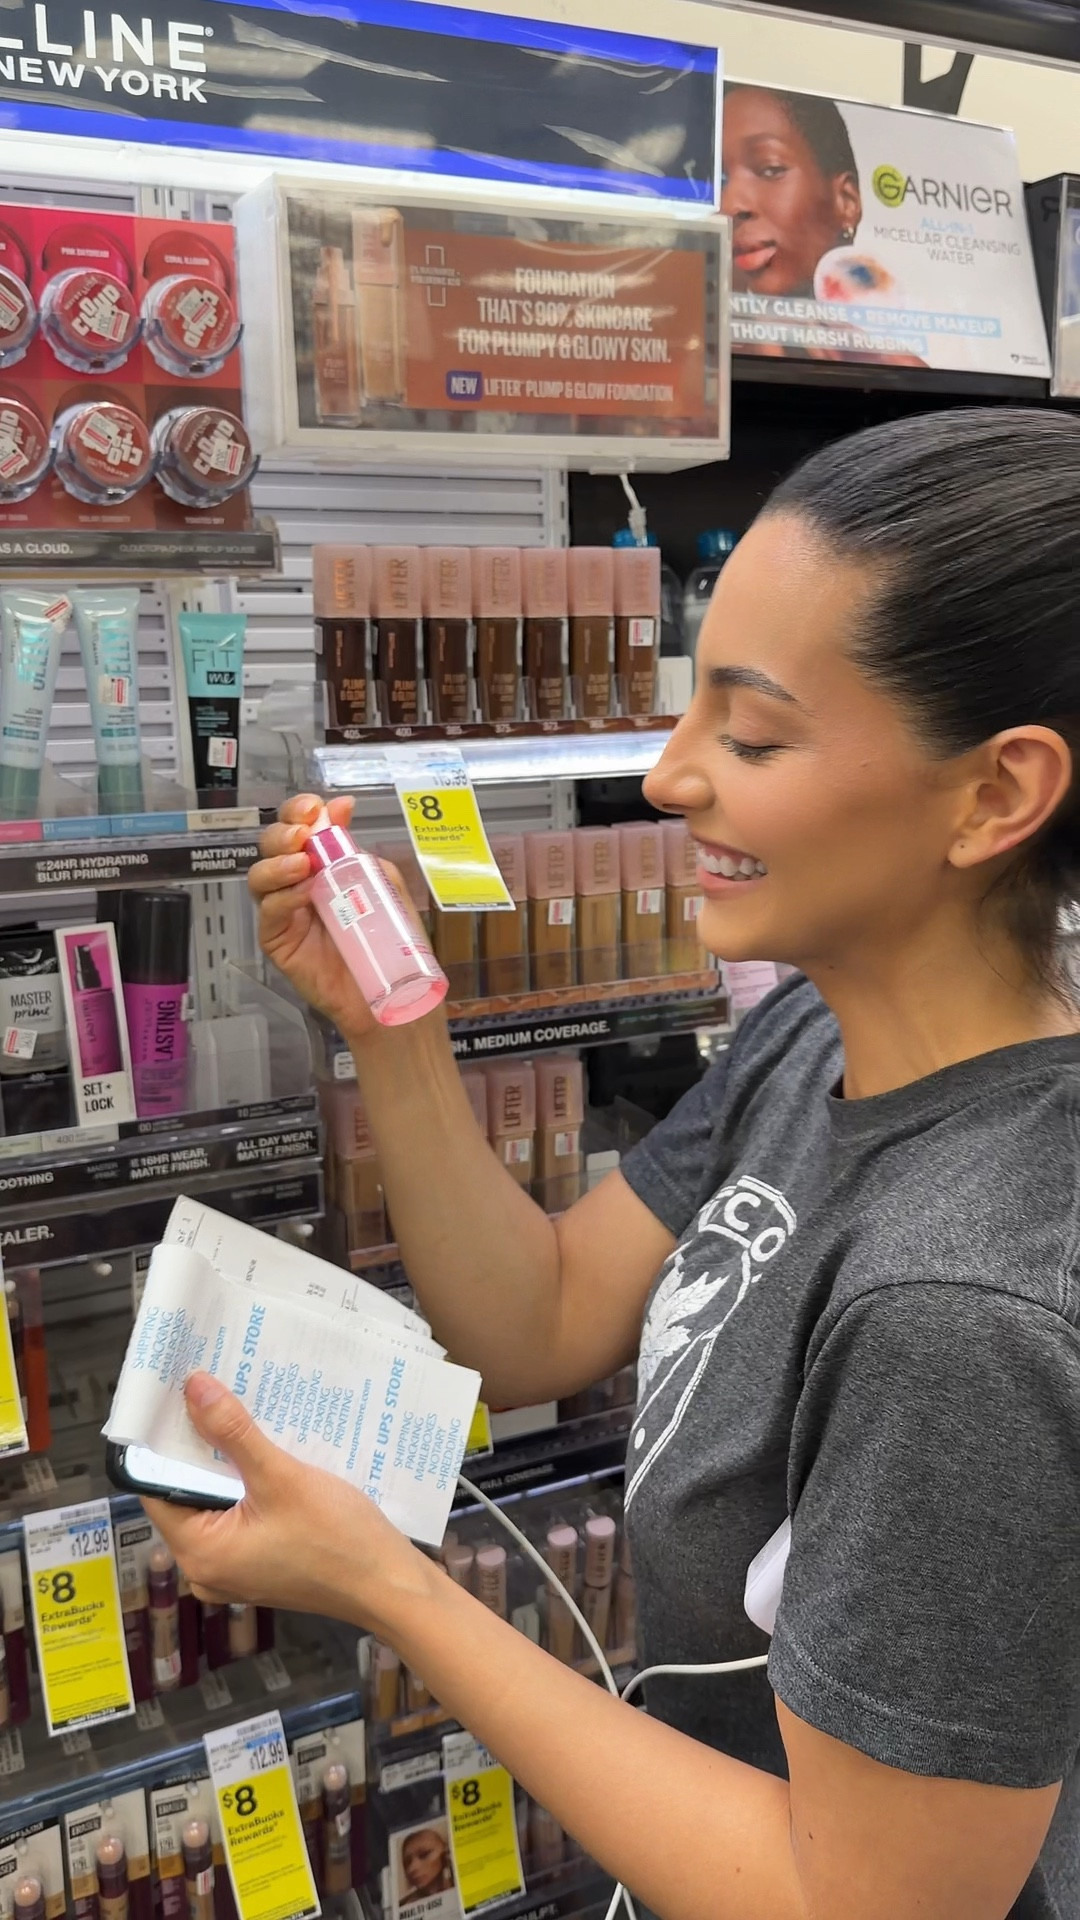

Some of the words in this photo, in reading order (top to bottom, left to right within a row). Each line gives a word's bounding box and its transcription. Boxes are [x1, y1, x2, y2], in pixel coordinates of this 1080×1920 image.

[94, 65, 208, 104] YORK
[873, 225, 942, 247] MICELLAR
[945, 234, 1021, 256] CLEANSING
[927, 249, 974, 265] WATER
[515, 268, 615, 298] FOUNDATION
[477, 297, 533, 326] THAT'S
[574, 303, 653, 331] SKINCARE
[773, 300, 848, 321] CLEANSE
[866, 311, 931, 330] REMOVE
[935, 317, 998, 336] MAKEUP
[457, 327, 493, 355] FOR
[493, 331, 559, 358] PLUMPY
[573, 335, 629, 361] GLOWY
[631, 338, 672, 363] SKIN.
[794, 328, 850, 348] HARSH
[853, 336, 923, 354] RUBBING
[450, 377, 478, 395] NEW
[525, 380, 564, 398] PLUMP
[574, 382, 605, 400] GLOW
[607, 384, 674, 402] FOUNDATION
[14, 544, 23, 553] A
[25, 543, 74, 555] CLOUD.
[192, 650, 235, 673] FIT
[407, 795, 443, 821] $8
[414, 824, 470, 833] ExtraBucks
[80, 854, 149, 868] HYDRATING
[190, 847, 258, 860] MATTIFYING
[191, 859, 237, 871] PRIMER
[37, 872, 71, 883] BLUR
[74, 867, 120, 880] PRIMER
[10, 991, 52, 1008] MASTER
[14, 1007, 50, 1023] prime
[155, 1000, 176, 1064] LASTING
[474, 1031, 531, 1050] MEDIUM
[534, 1020, 611, 1042] COVERAGE.
[83, 1082, 104, 1097] SET
[85, 1097, 115, 1113] LOCK
[504, 1085, 522, 1129] LIFTER
[171, 1148, 209, 1161] WEAR.
[236, 1140, 257, 1151] ALL
[259, 1135, 280, 1147] DAY
[281, 1130, 317, 1143] WEAR.
[236, 1149, 273, 1162] MATTE
[129, 1165, 169, 1180] MATTE
[171, 1158, 211, 1173] FINISH.
[133, 1306, 159, 1369] SHIPPING
[148, 1311, 173, 1370] PACKING
[159, 1307, 186, 1383] MAILBOXES
[242, 1302, 266, 1358] STORE
[233, 1360, 253, 1397] UPS
[252, 1359, 275, 1421] SHIPPING
[263, 1366, 286, 1422] PACKING
[385, 1356, 406, 1409] STORE
[274, 1362, 300, 1434] MAILBOXES
[289, 1376, 308, 1427] NOTARY
[298, 1368, 323, 1445] SHREDDING
[312, 1386, 331, 1434] FAXING
[322, 1385, 343, 1443] COPYING
[333, 1388, 354, 1449] PRINTING
[346, 1378, 372, 1470] theupsstore.com
[376, 1411, 393, 1446] UPS
[394, 1410, 414, 1469] SHIPPING
[405, 1416, 424, 1470] PACKING
[414, 1412, 437, 1482] MAILBOXES
[428, 1426, 447, 1475] NOTARY
[436, 1418, 461, 1491] SHREDDING
[369, 1449, 387, 1481] THE
[71, 1528, 110, 1557] $12.99
[38, 1571, 76, 1603] $8
[41, 1601, 105, 1622] ExtraBucks
[222, 1785, 257, 1817] $8
[228, 1809, 286, 1836] ExtraBucks
